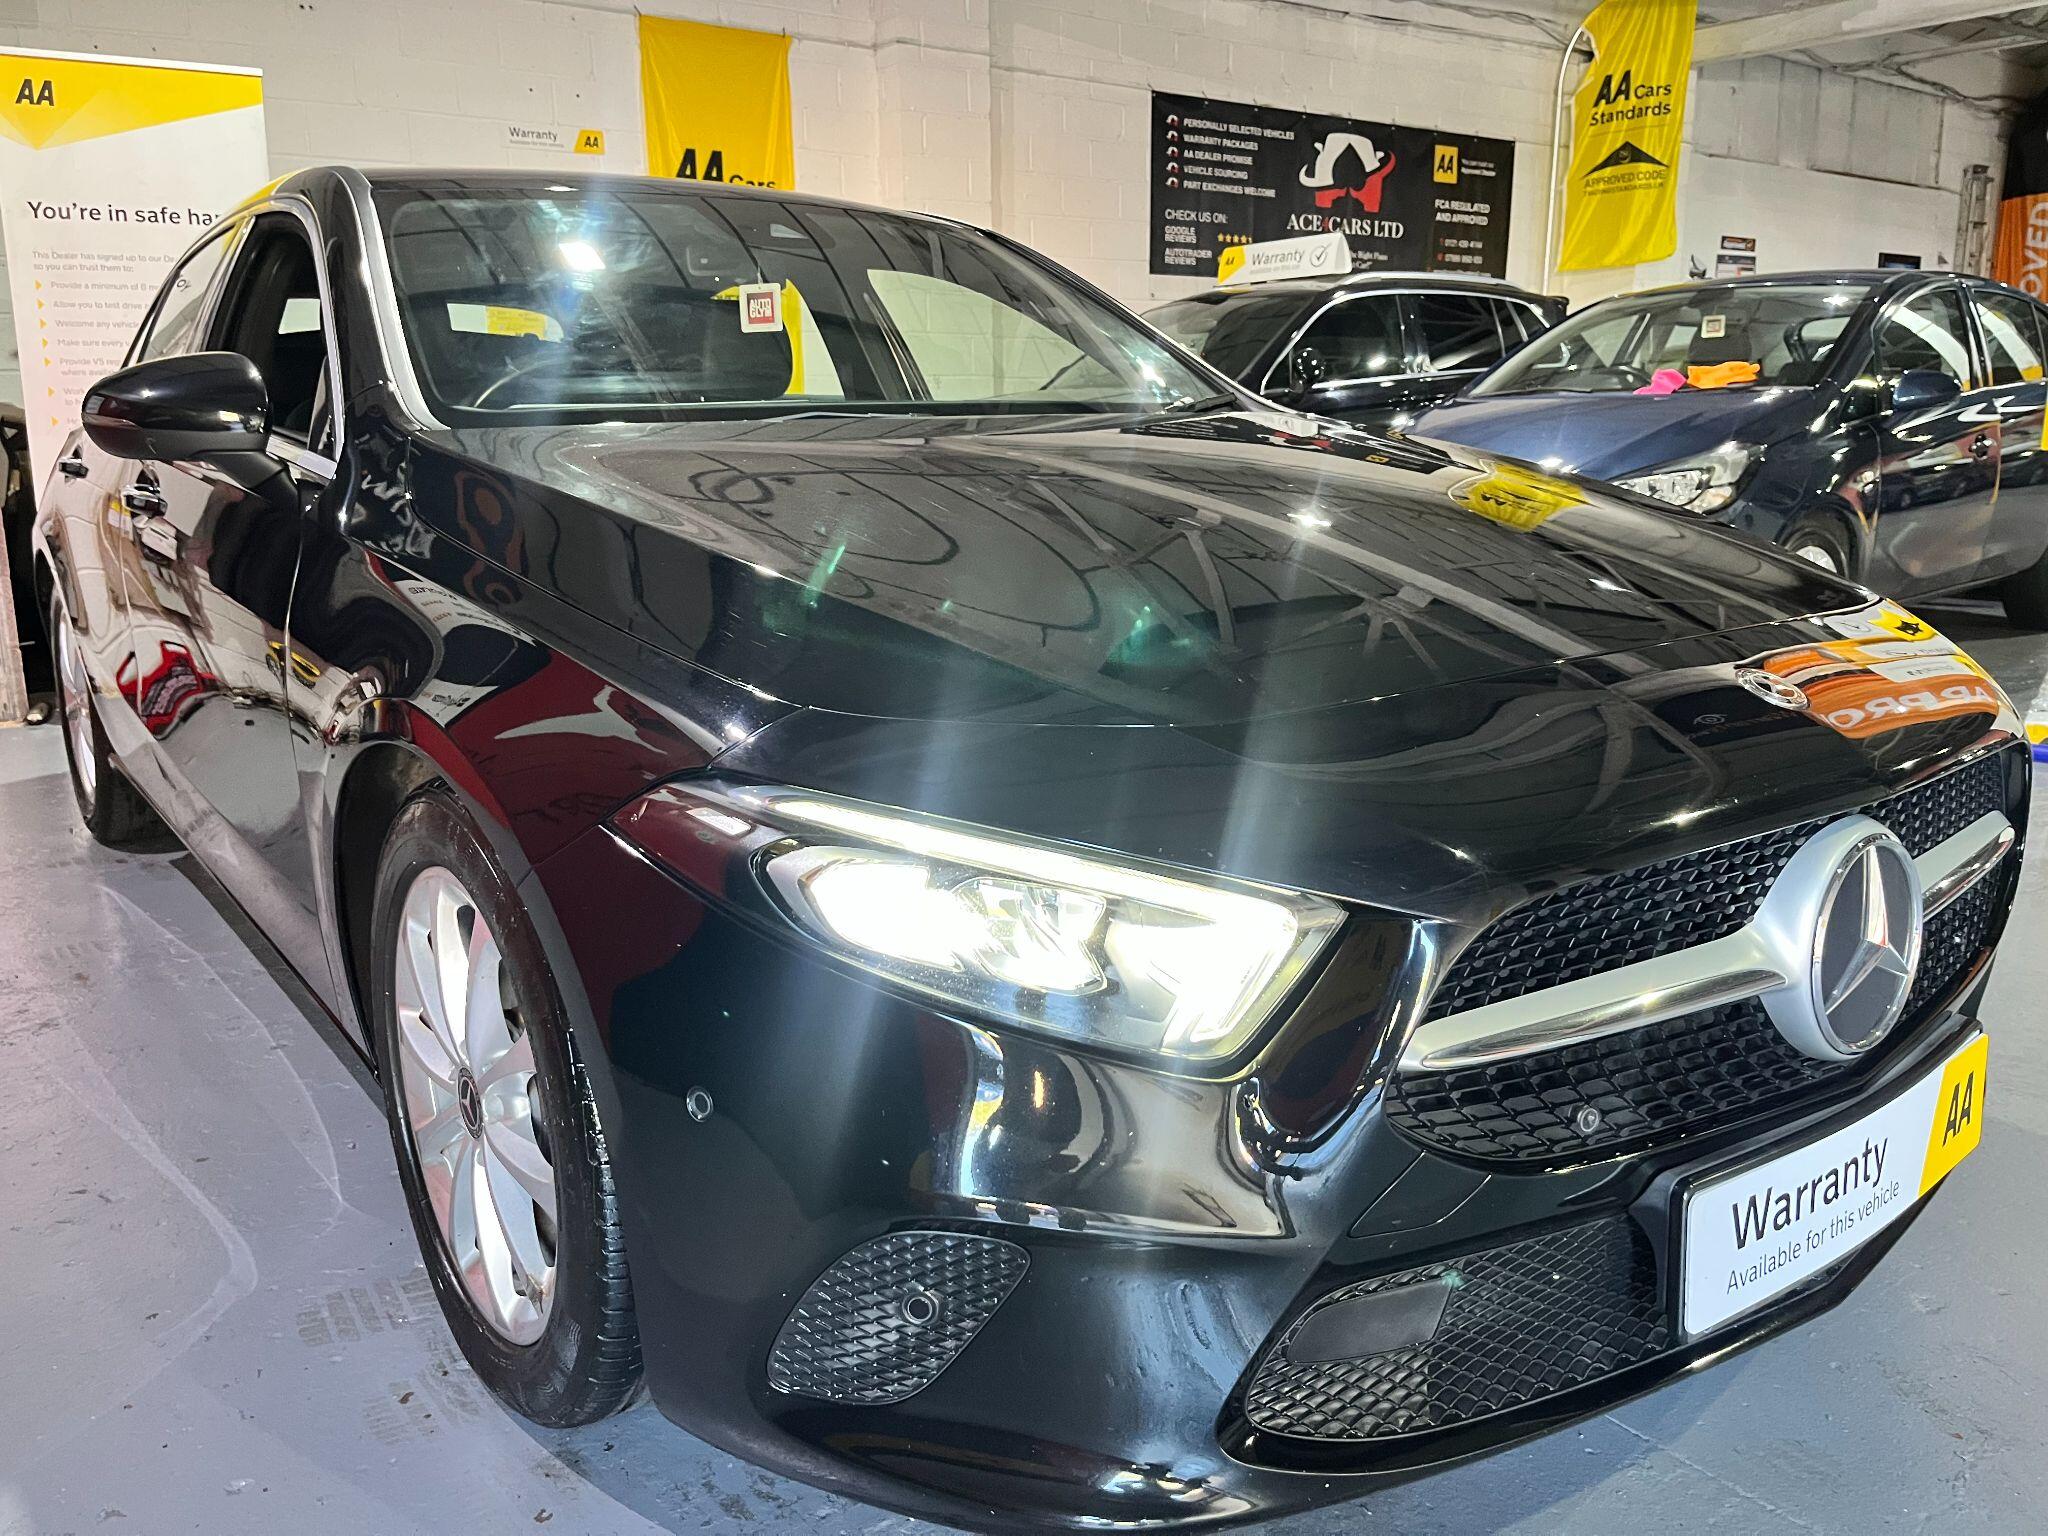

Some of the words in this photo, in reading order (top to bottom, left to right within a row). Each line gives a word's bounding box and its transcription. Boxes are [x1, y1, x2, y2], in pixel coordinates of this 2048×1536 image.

[15, 78, 55, 107] AA
[1593, 70, 1631, 108] AA
[1635, 84, 1672, 99] Cars
[1589, 101, 1672, 126] Standards
[509, 126, 557, 143] Warranty
[1183, 118, 1228, 132] PERSONALLY
[1228, 124, 1262, 136] SELECTED
[1263, 128, 1295, 140] VEHICLES
[584, 136, 599, 148] AA
[1183, 134, 1221, 146] WARRANTY
[1222, 139, 1259, 151] PACKAGES
[676, 148, 724, 183] AA
[1183, 150, 1194, 158] AA
[1195, 150, 1222, 161] DEALER
[1222, 153, 1253, 165] PROMISE
[1437, 154, 1454, 175] AA
[1183, 165, 1213, 176] VEHICLE
[1214, 168, 1248, 180] SOURCING
[1584, 173, 1634, 188] APPROVED
[1637, 169, 1667, 181] CODE
[1183, 180, 1201, 190] PART
[1202, 181, 1244, 195] EXCHANGES
[1435, 199, 1450, 209] FCA
[108, 204, 128, 222] in
[135, 206, 181, 225] safe
[188, 208, 220, 226] ha
[1164, 208, 1197, 221] CHECK
[1198, 211, 1212, 223] US
[1435, 211, 1452, 223] AND
[1164, 225, 1196, 236] GOOGLE
[1373, 220, 1404, 239] LTD
[1164, 234, 1197, 243] REVIEWS
[1164, 256, 1197, 266] REVIEWS
[1252, 249, 1306, 266] Warranty
[1942, 1071, 1975, 1148] AA
[1731, 1136, 1888, 1251] Warranty
[1727, 1240, 1802, 1296] Available
[1806, 1226, 1828, 1253] for
[1830, 1209, 1855, 1240] this
[1858, 1180, 1901, 1222] vehicle
